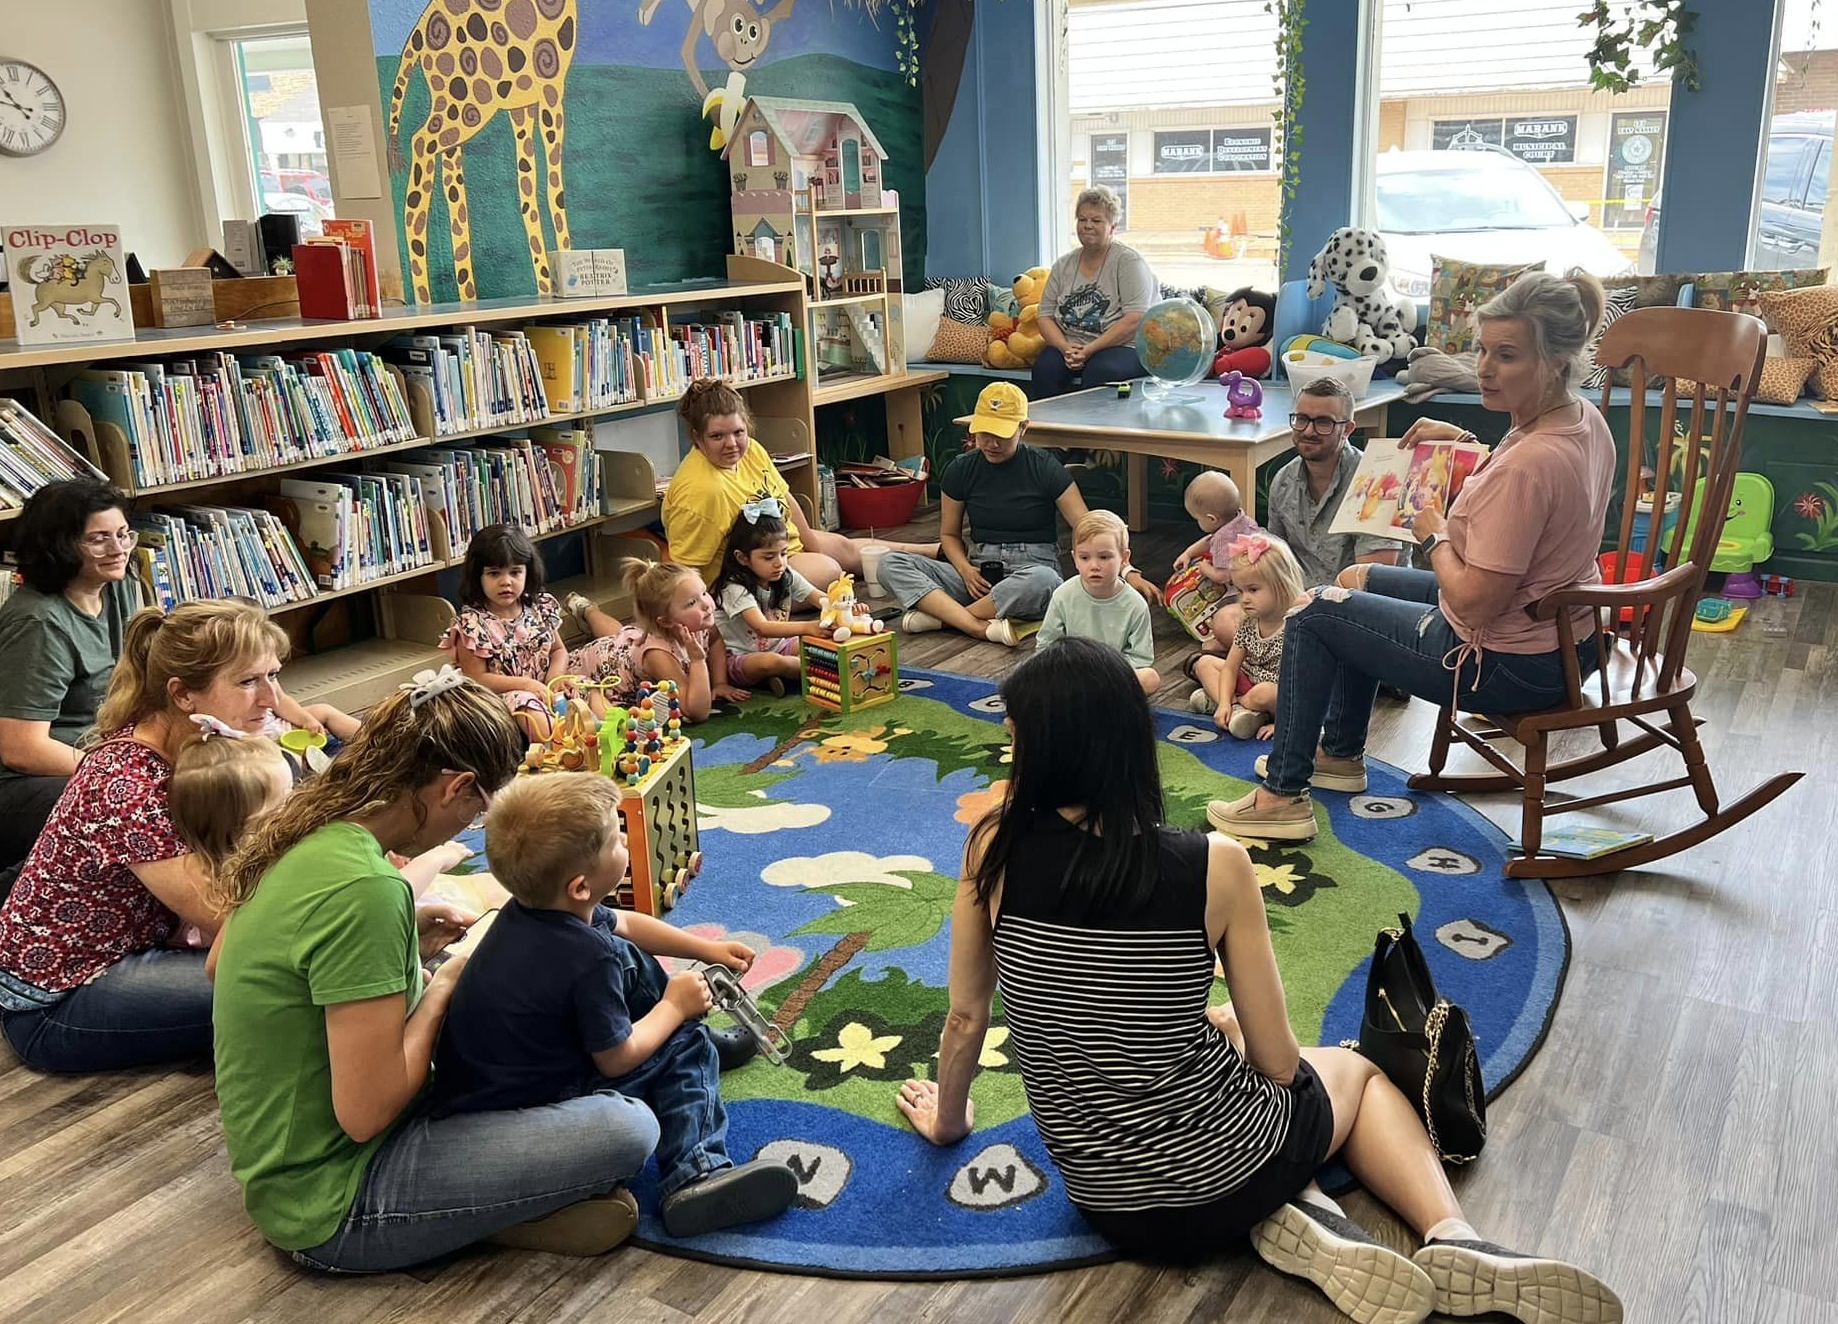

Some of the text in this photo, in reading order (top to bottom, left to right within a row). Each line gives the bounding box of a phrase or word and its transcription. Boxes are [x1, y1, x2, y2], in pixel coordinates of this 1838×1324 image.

[1516, 122, 1566, 134] MABANK
[1512, 142, 1566, 150] MUNICIPAL
[1162, 147, 1202, 157] MABANK
[8, 228, 118, 250] Clip-Clop
[1179, 731, 1202, 740] E
[1364, 802, 1395, 813] G
[1428, 856, 1461, 869] H
[968, 1164, 1016, 1195] W
